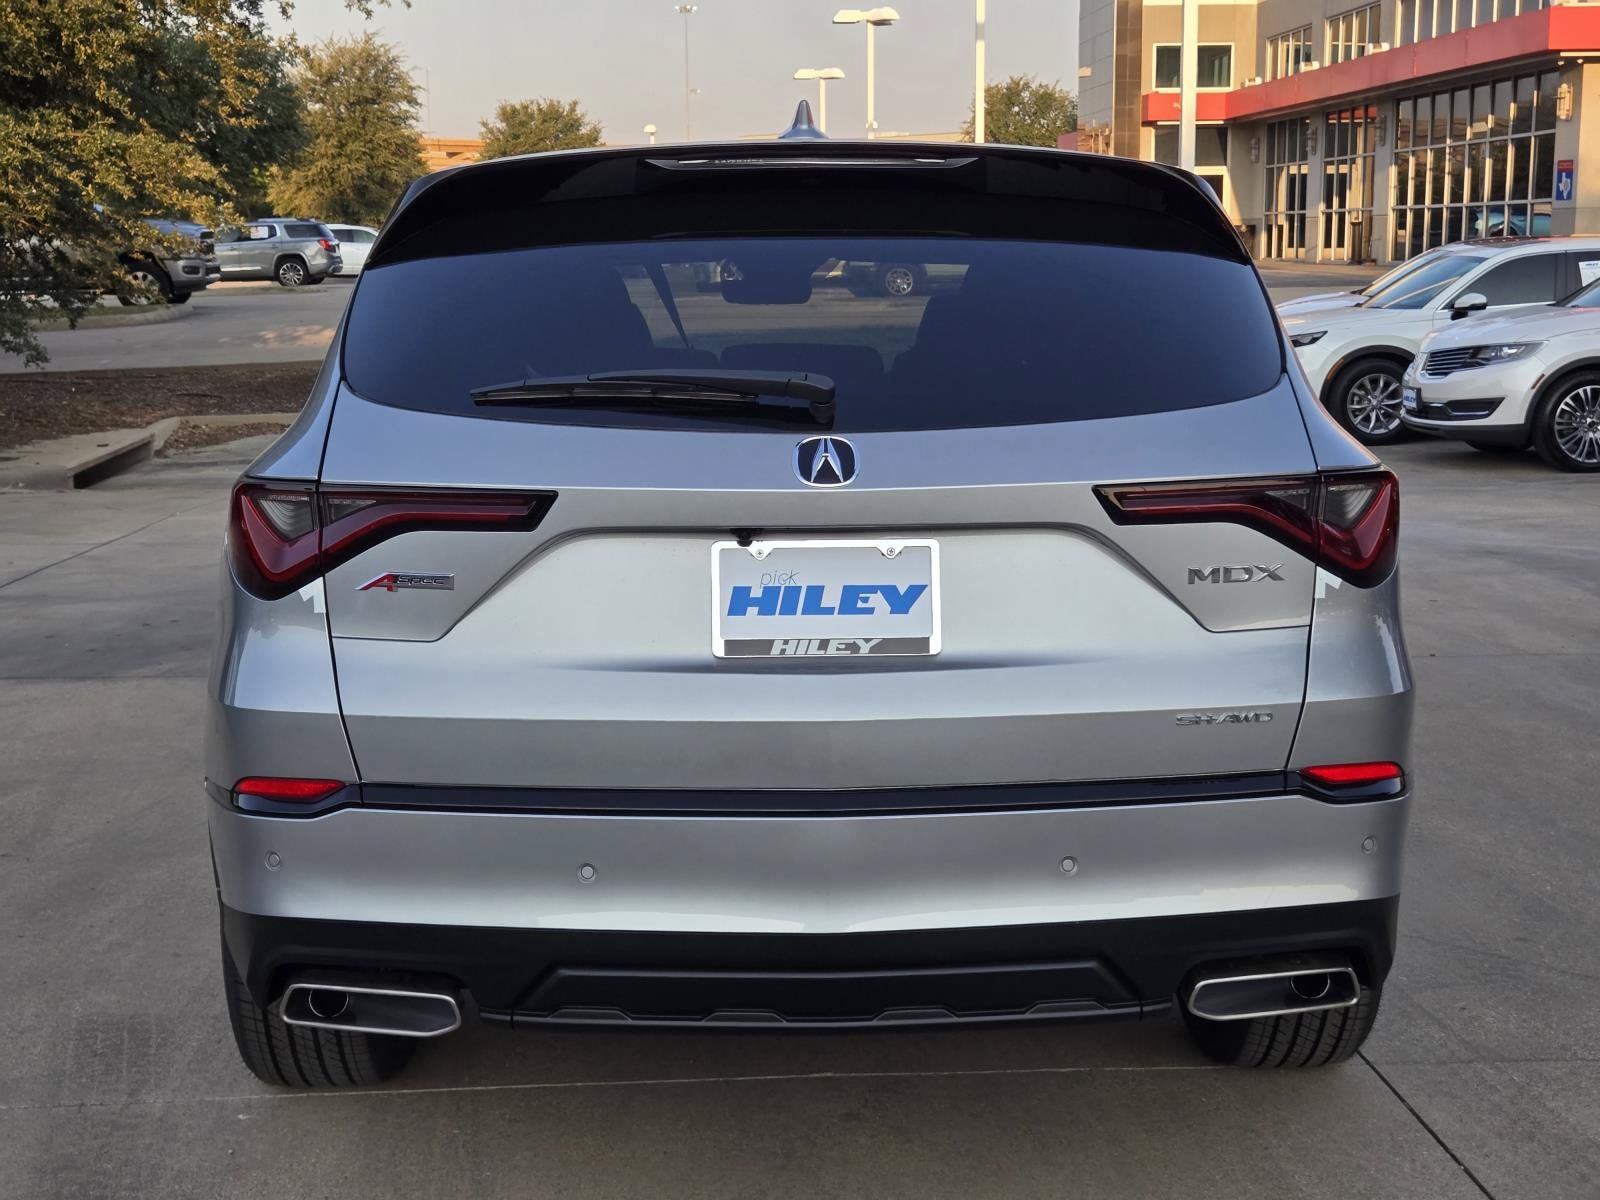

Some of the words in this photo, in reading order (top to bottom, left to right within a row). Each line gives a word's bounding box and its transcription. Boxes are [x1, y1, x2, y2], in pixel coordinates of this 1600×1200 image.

[760, 569, 800, 588] pick
[1187, 562, 1286, 585] MDX
[727, 584, 928, 616] HILEY
[770, 638, 884, 656] HILEY
